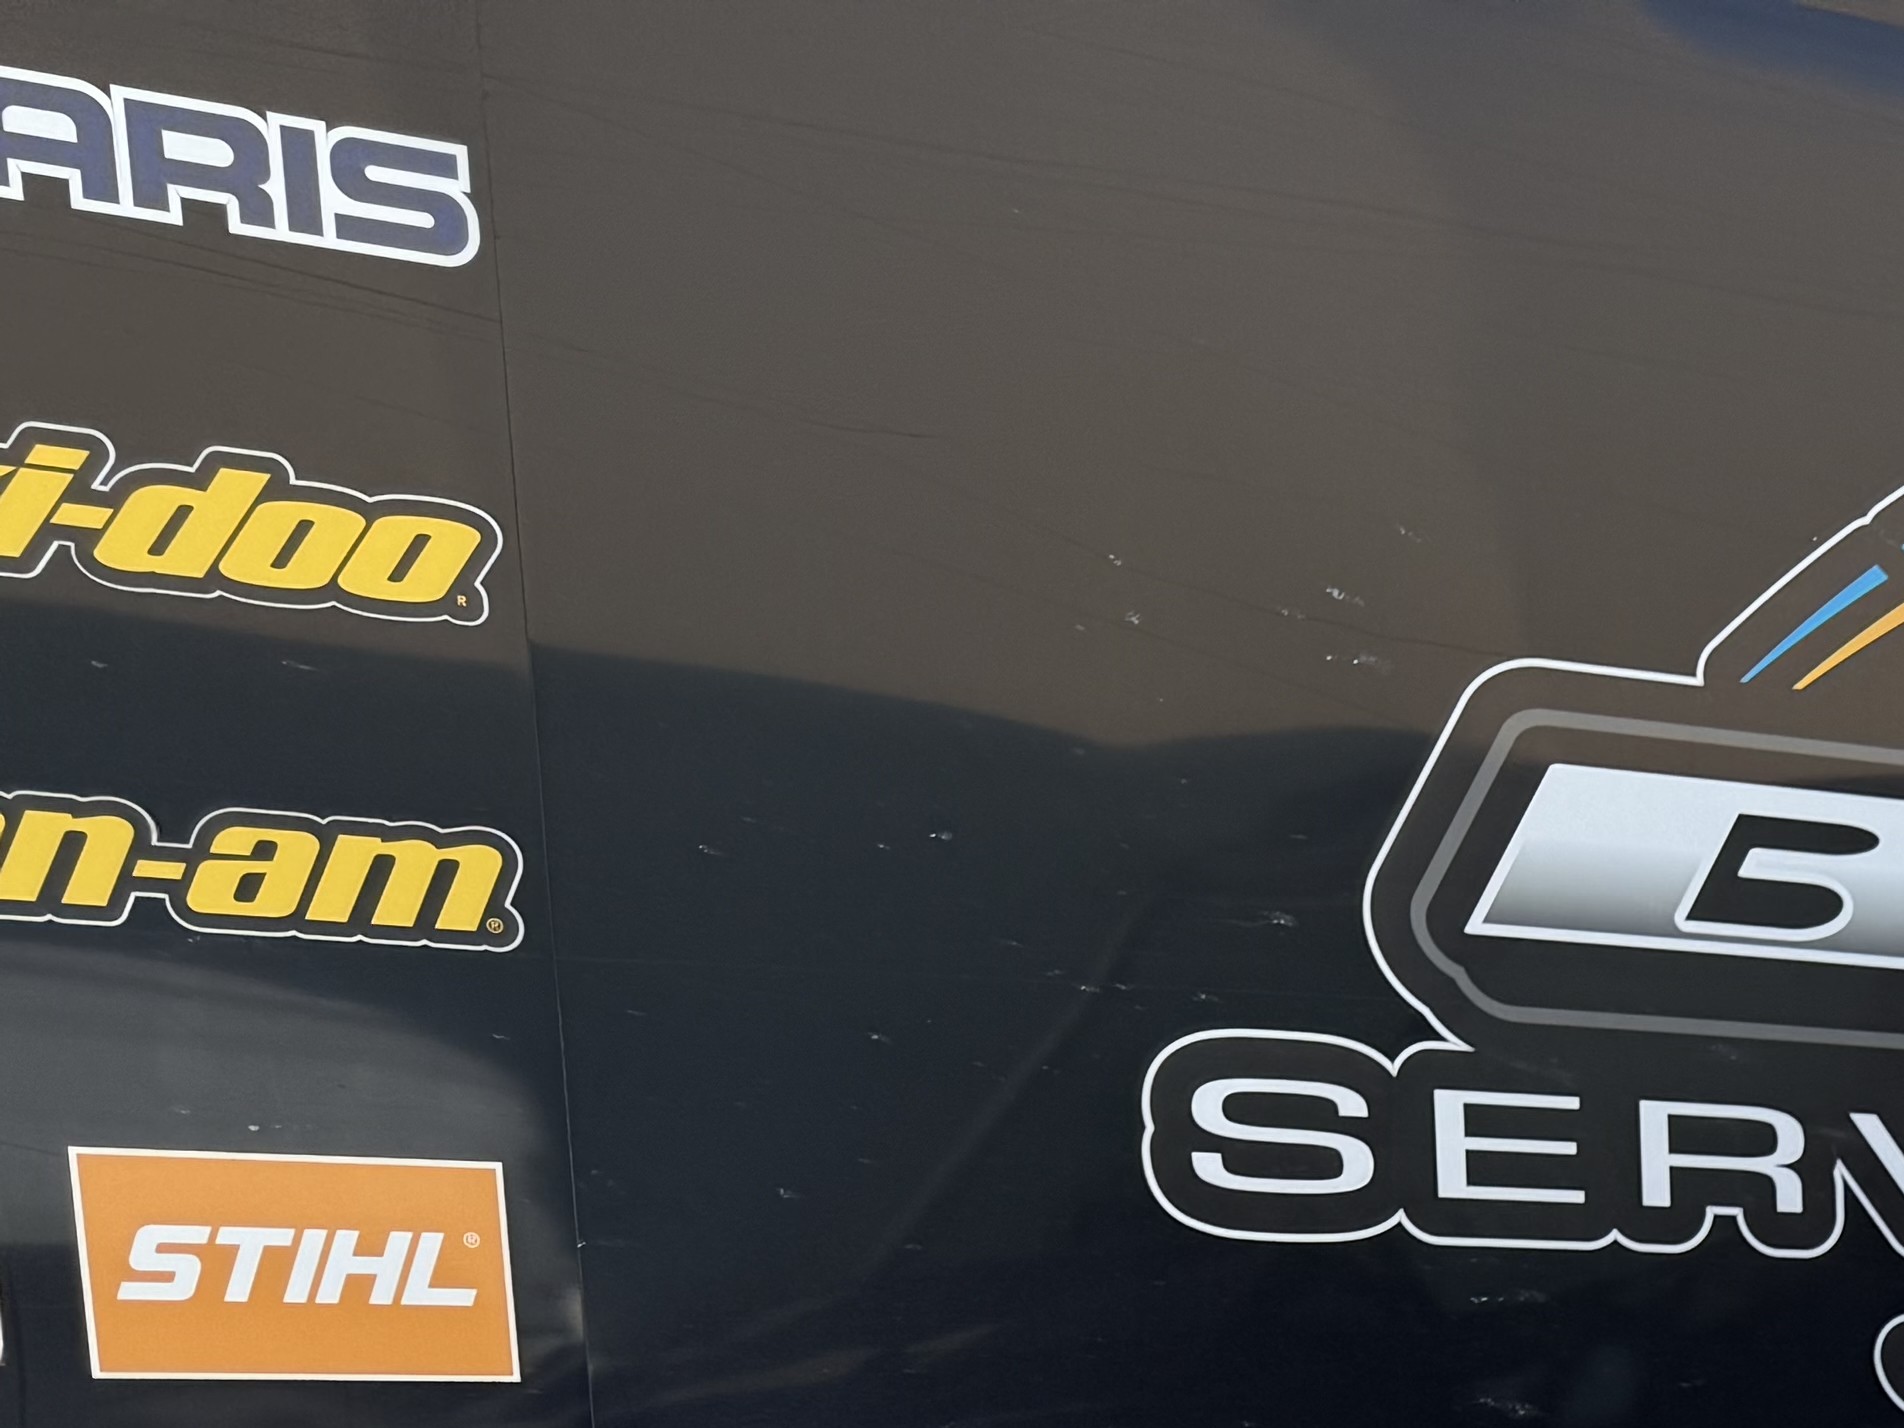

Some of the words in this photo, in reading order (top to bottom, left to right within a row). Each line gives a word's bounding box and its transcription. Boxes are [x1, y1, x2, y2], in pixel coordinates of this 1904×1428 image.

[0, 444, 482, 603] i-doo
[0, 809, 503, 932] n-am
[116, 1223, 479, 1307] STIHL
